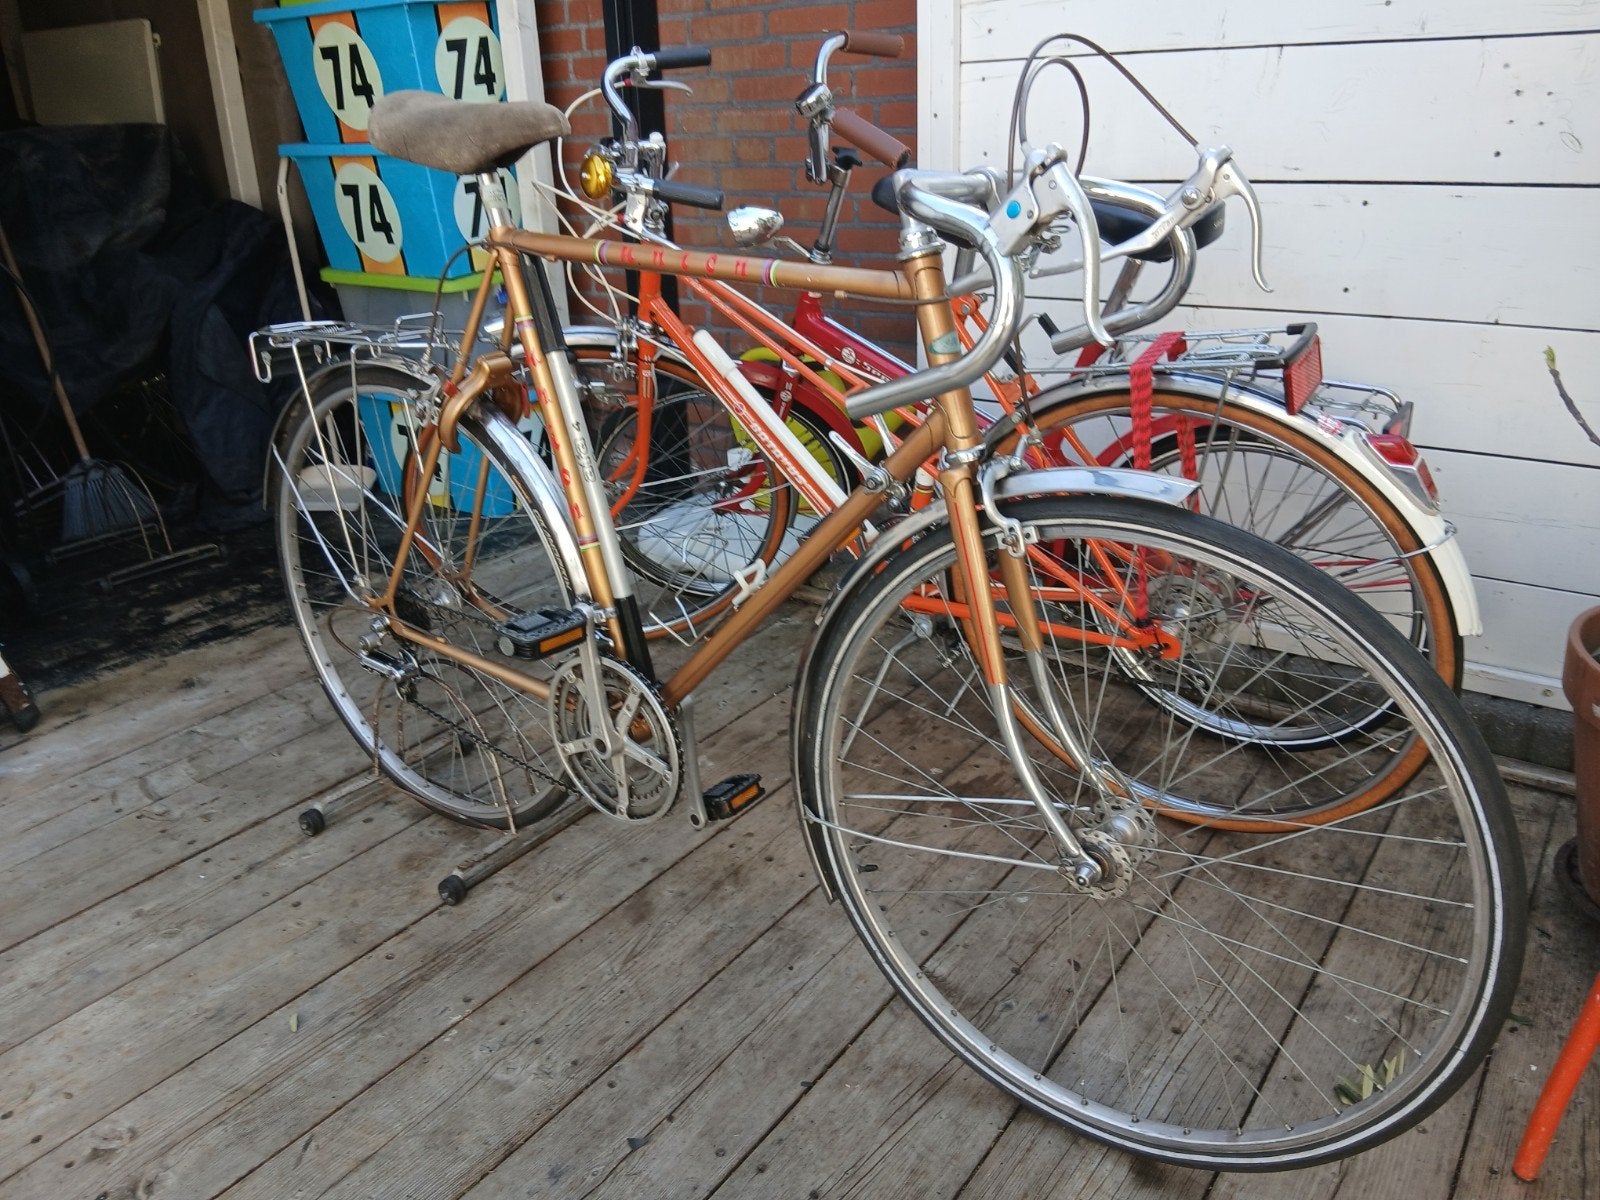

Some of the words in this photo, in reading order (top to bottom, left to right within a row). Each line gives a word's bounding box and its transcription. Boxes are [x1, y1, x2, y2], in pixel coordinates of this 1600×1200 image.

[319, 43, 375, 110] 74
[446, 36, 496, 100] 74
[340, 183, 395, 245] 74
